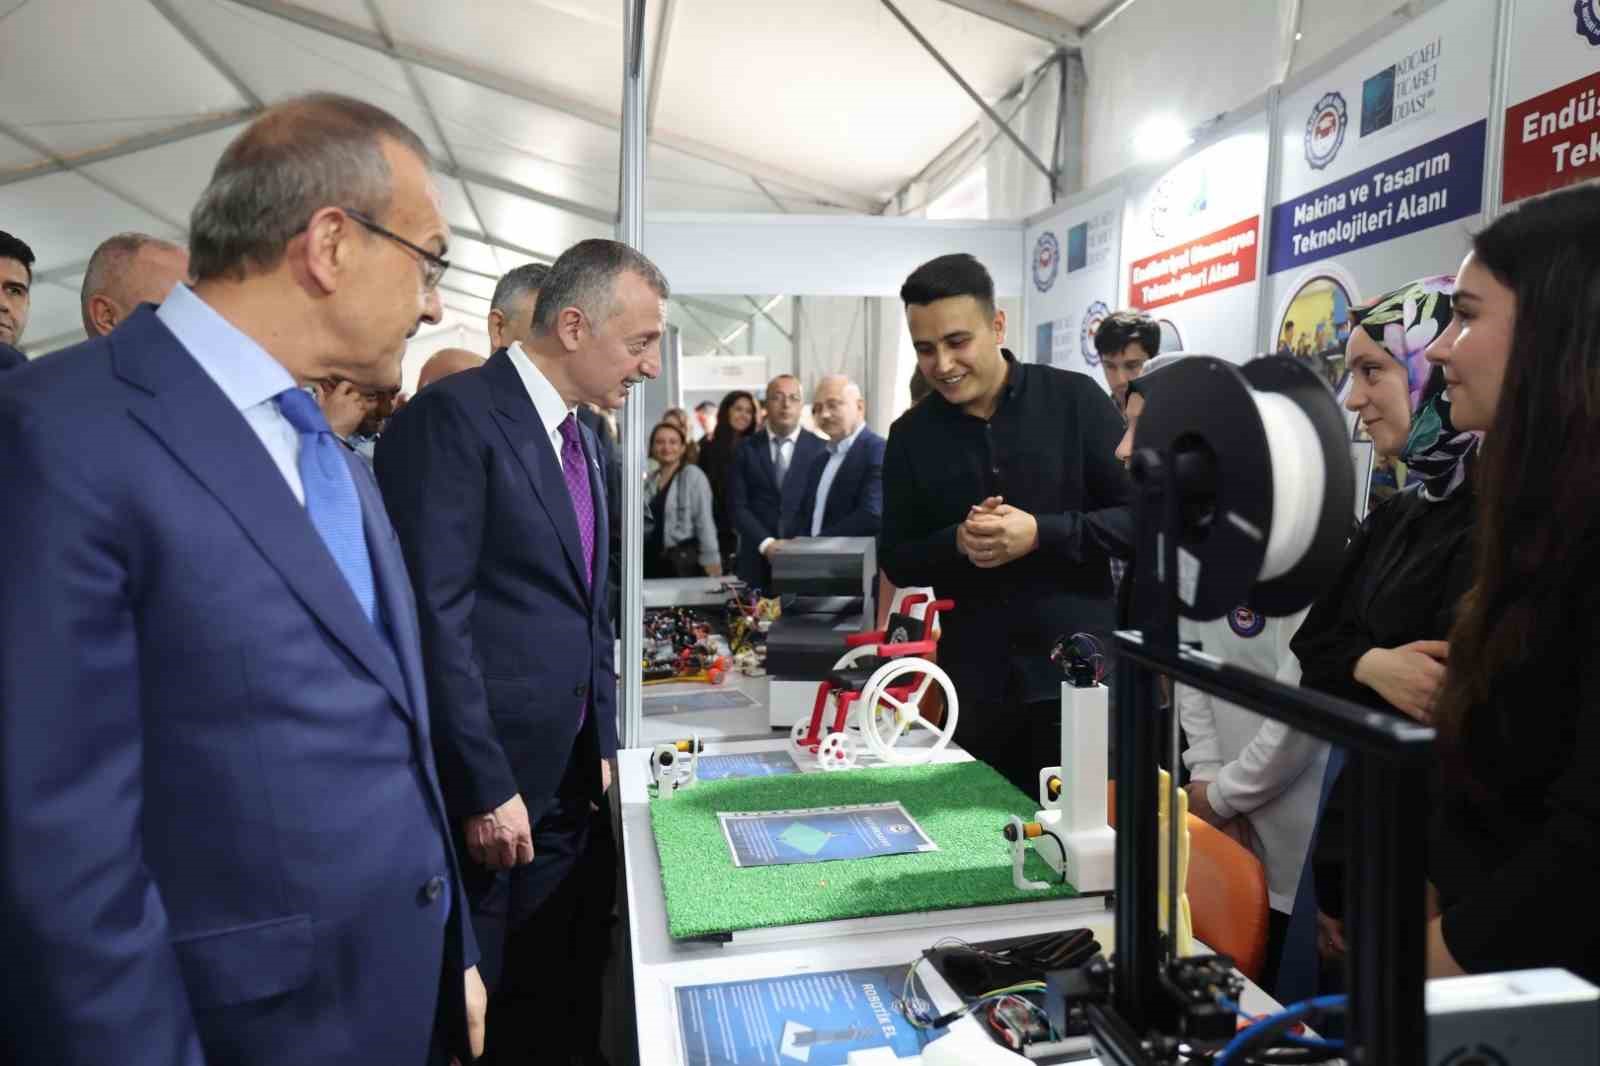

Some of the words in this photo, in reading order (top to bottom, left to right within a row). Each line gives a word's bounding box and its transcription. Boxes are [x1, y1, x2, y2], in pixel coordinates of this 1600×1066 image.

[1522, 89, 1600, 143] Endü
[1292, 203, 1393, 256] Teknolojileri
[1396, 189, 1448, 223] Alanı
[1293, 193, 1347, 228] Makina
[1350, 184, 1369, 206] ve
[1373, 152, 1450, 197] Tasarım
